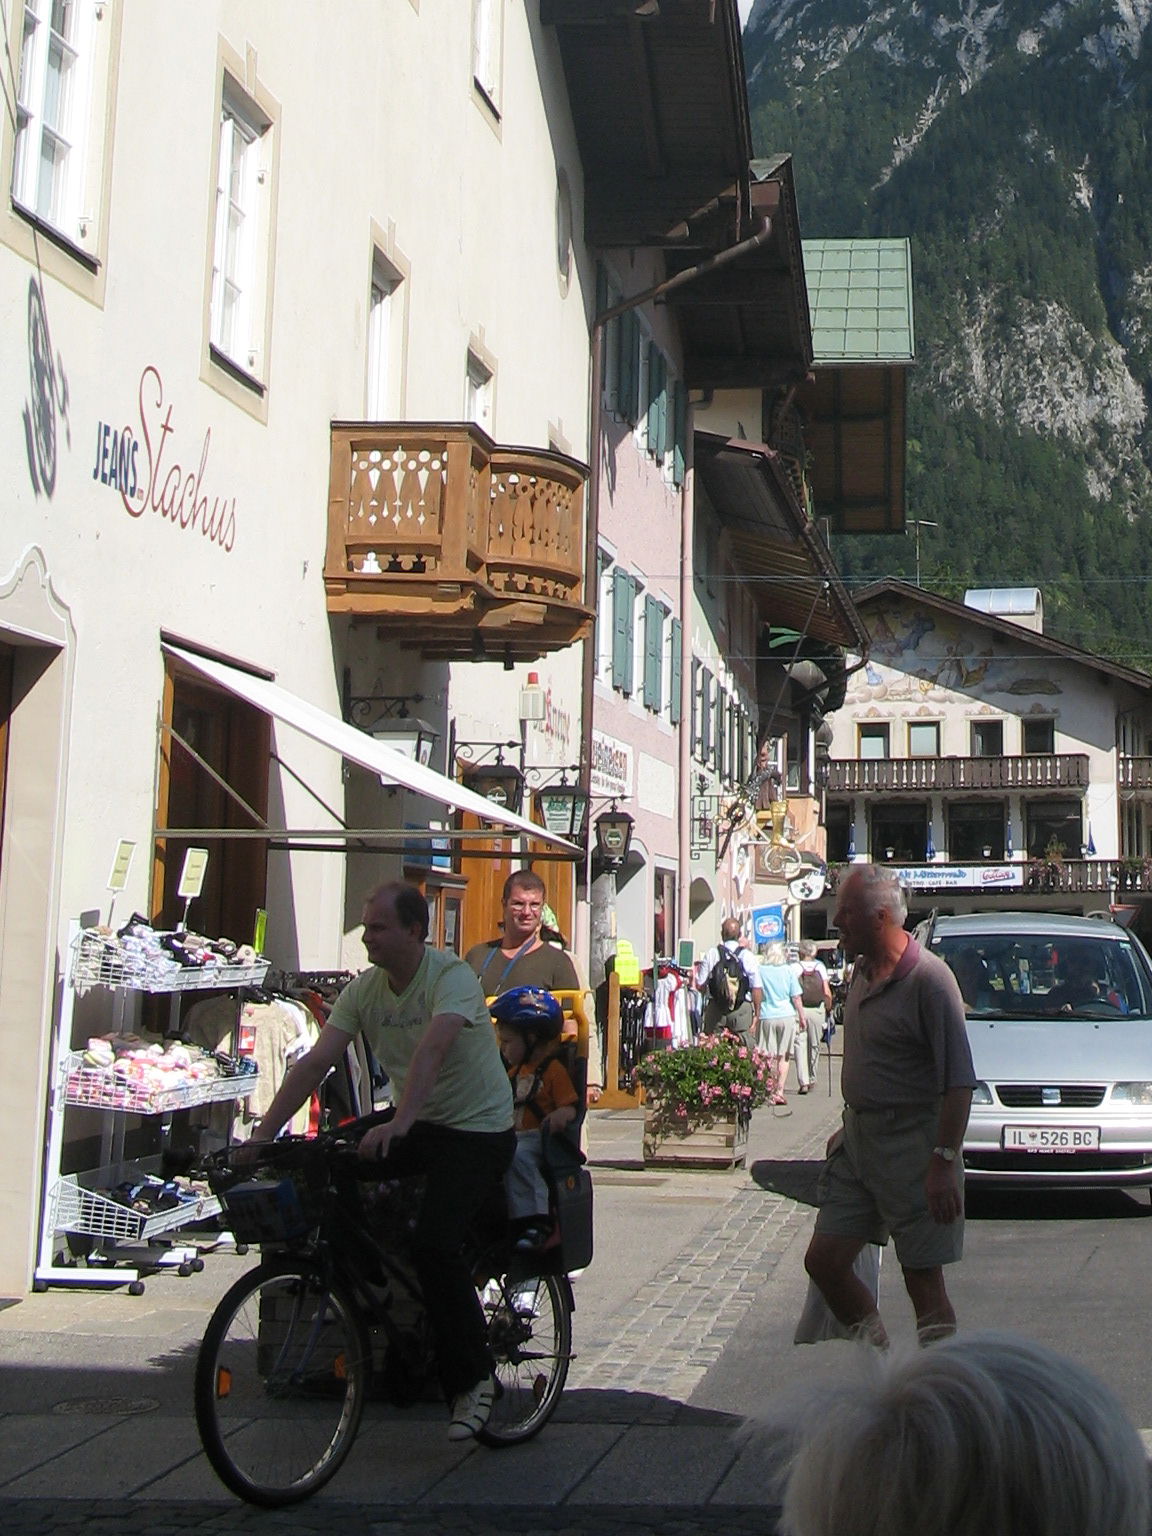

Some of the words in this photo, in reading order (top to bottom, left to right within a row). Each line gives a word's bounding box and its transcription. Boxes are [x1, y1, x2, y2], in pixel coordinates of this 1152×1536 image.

[93, 421, 138, 498] JEANS
[119, 365, 236, 553] Stachus
[1013, 1131, 1026, 1145] IL
[1040, 1131, 1069, 1146] 526
